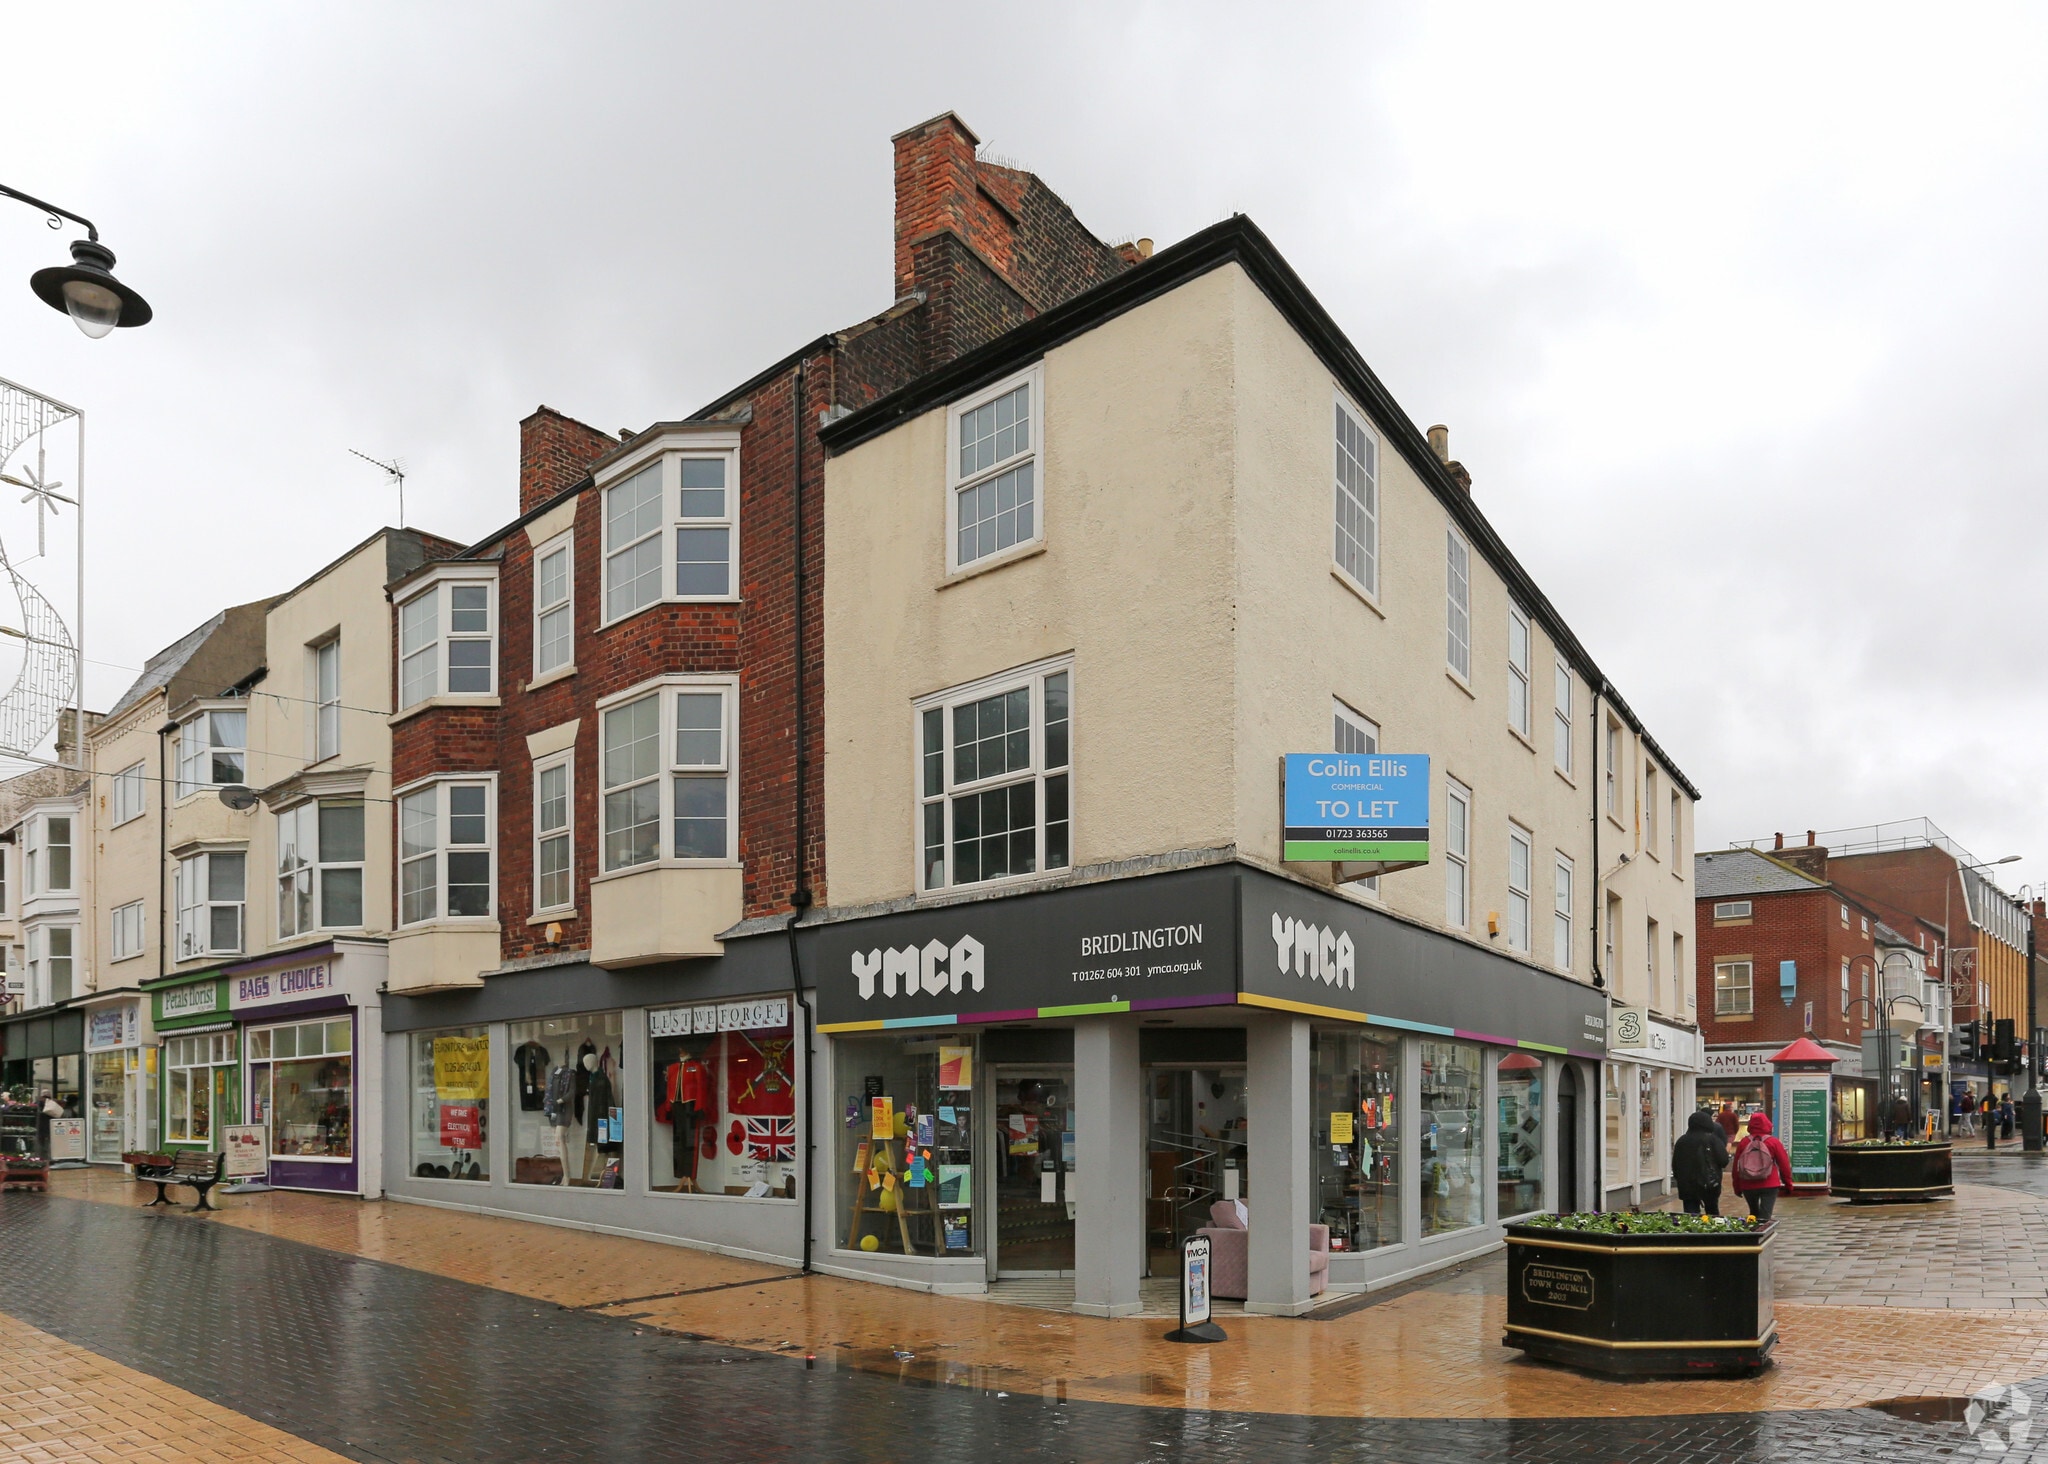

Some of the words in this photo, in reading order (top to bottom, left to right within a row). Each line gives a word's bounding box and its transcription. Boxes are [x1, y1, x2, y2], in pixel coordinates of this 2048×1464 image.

[1307, 759, 1361, 777] Colin
[1368, 759, 1408, 777] Ellis
[1331, 783, 1384, 791] COMMERCIAL
[1316, 801, 1350, 818] TO
[1357, 801, 1399, 818] LET
[1325, 829, 1353, 838] 01723
[1355, 829, 1388, 838] 363565
[1333, 847, 1381, 855] colinellis.co.uk
[1081, 923, 1203, 957] BRIDLINGTON
[1271, 911, 1355, 992] YMCA
[851, 934, 985, 1001] YMCA
[1072, 972, 1078, 982] T
[1079, 969, 1105, 982] 01262
[1106, 967, 1123, 979] 604
[1124, 965, 1141, 977] 301
[1147, 959, 1203, 978] ymca.org.uk
[239, 975, 269, 1001] BAGS
[280, 965, 324, 994] CHOICE
[165, 987, 188, 1010] Petals
[189, 984, 214, 1006] florist
[652, 1013, 690, 1030] LEST
[694, 1010, 714, 1025] WE
[721, 1003, 786, 1023] FORGET
[1618, 1012, 1640, 1039] 3
[434, 1042, 465, 1054] FURNITURE
[1706, 1054, 1766, 1066] SAMUEL
[1715, 1067, 1767, 1075] JEWELLER
[1187, 1247, 1208, 1258] YMCA
[1533, 1269, 1583, 1282] BRIDLINGTON
[1529, 1278, 1552, 1289] TOWN
[1555, 1282, 1588, 1294] COUNCIL
[1548, 1291, 1567, 1301] 2003
